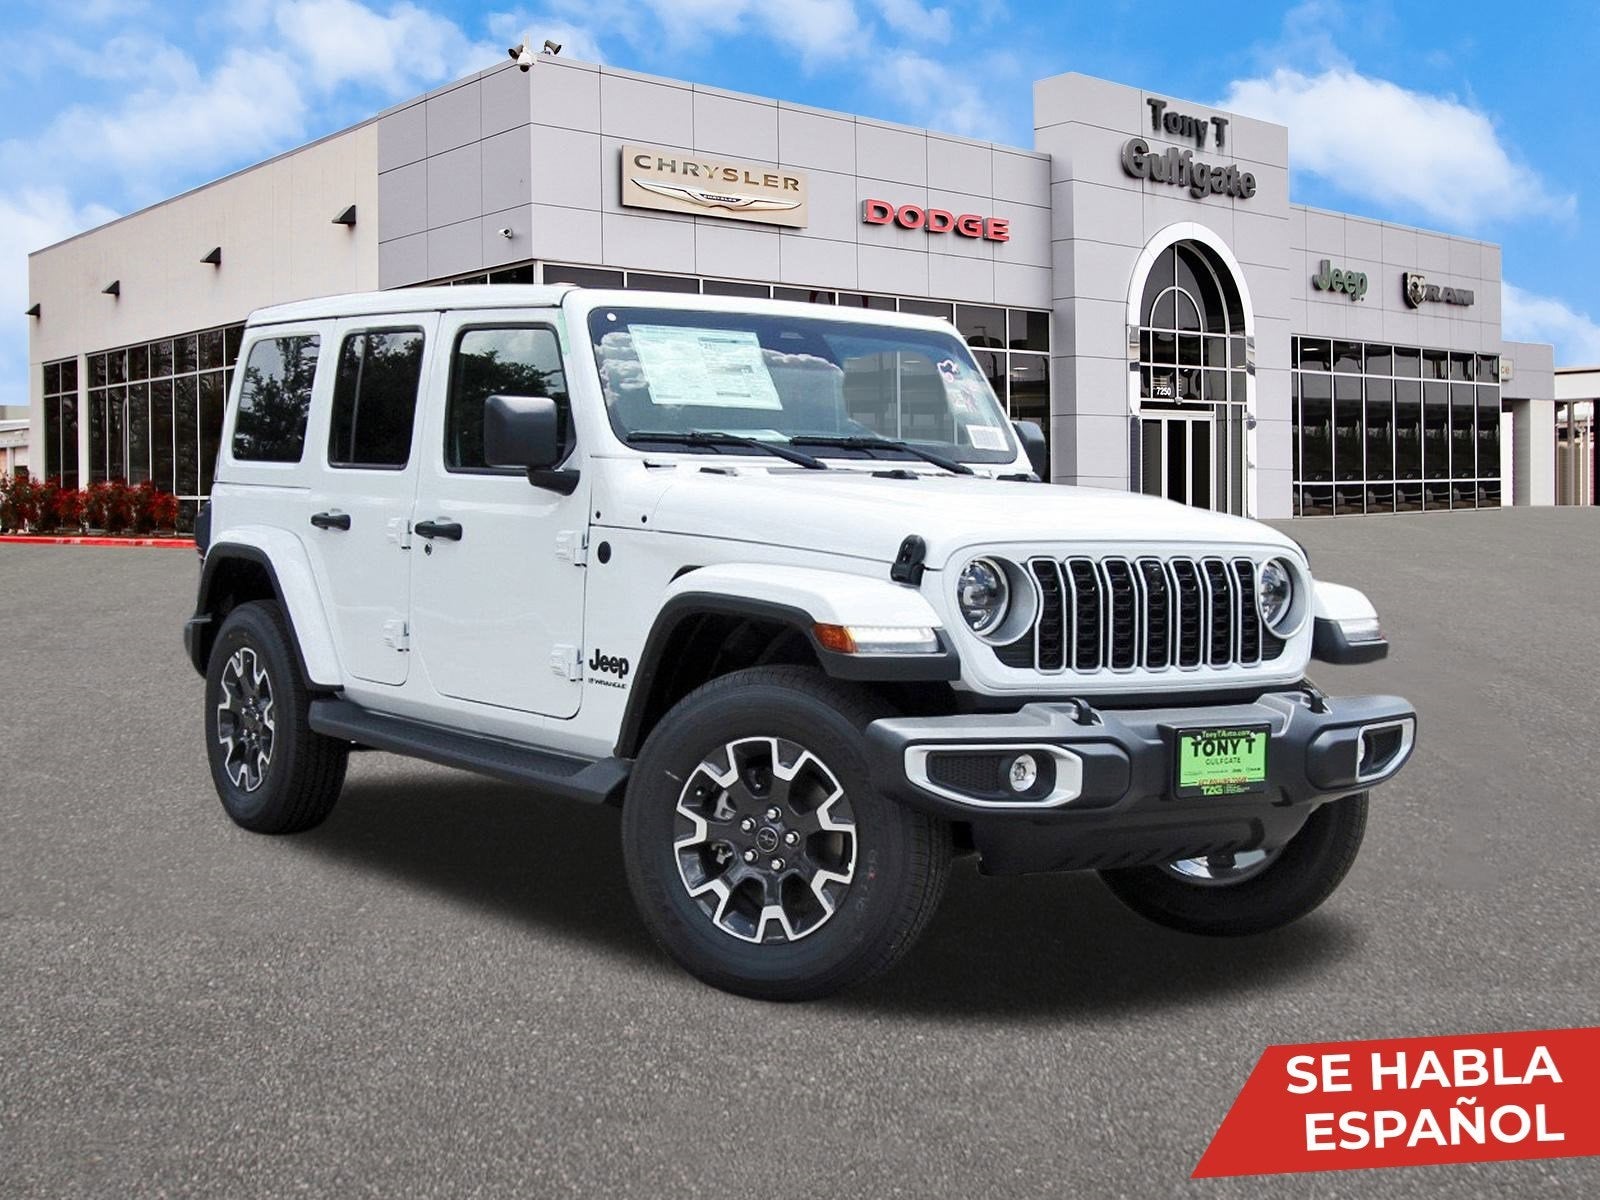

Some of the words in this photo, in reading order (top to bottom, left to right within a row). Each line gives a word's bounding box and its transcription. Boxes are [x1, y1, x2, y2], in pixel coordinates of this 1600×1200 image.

[1146, 98, 1209, 148] Tony
[1210, 116, 1229, 148] T
[633, 154, 800, 192] CHRYSLER
[1121, 138, 1257, 199] Gulfgate
[862, 199, 1010, 242] DODGE
[1312, 259, 1368, 302] Jeep
[1425, 284, 1475, 307] RAM
[1156, 387, 1171, 396] 7250
[589, 648, 629, 679] Jeep
[1191, 739, 1241, 757] TONY
[1245, 738, 1256, 754] T
